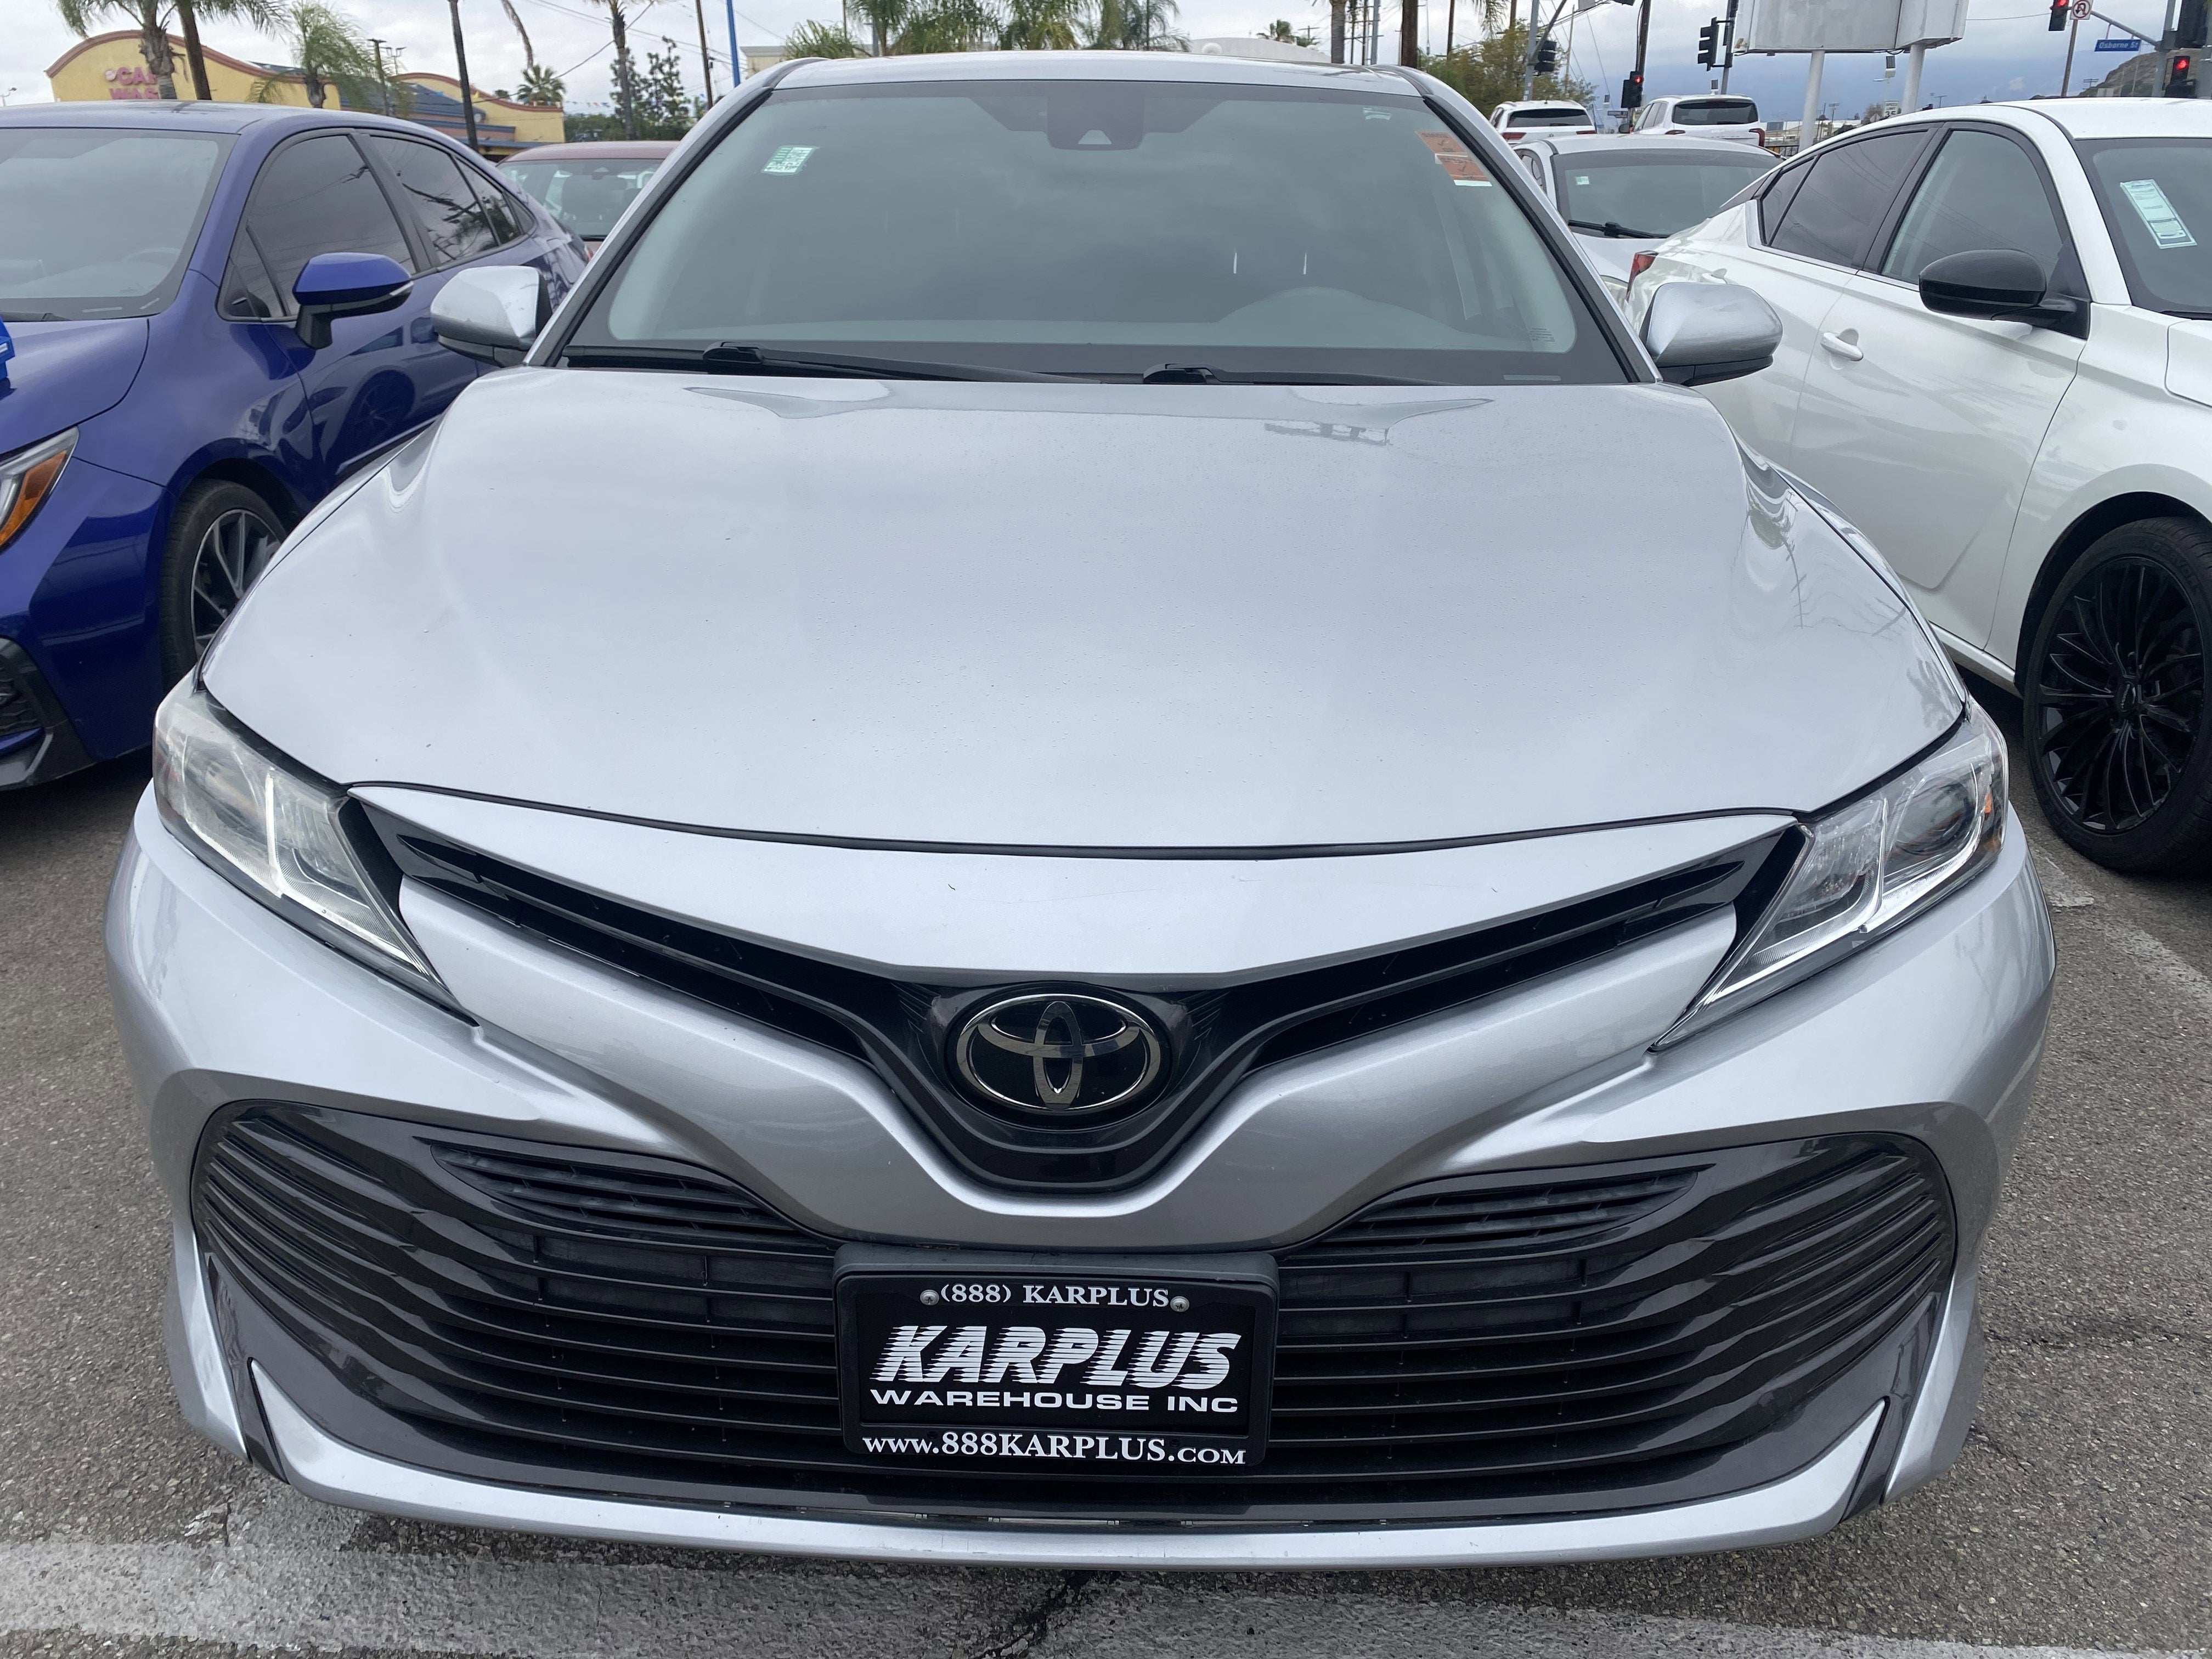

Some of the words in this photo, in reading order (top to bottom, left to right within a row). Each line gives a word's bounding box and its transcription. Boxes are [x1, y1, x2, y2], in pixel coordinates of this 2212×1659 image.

[109, 87, 159, 100] WAS
[940, 1284, 1011, 1303] (888)
[1023, 1285, 1169, 1307] KARPLUS
[870, 1325, 1242, 1390] KARPLUS
[870, 1389, 1149, 1410] WAREHOUSE
[1167, 1396, 1238, 1413] INC
